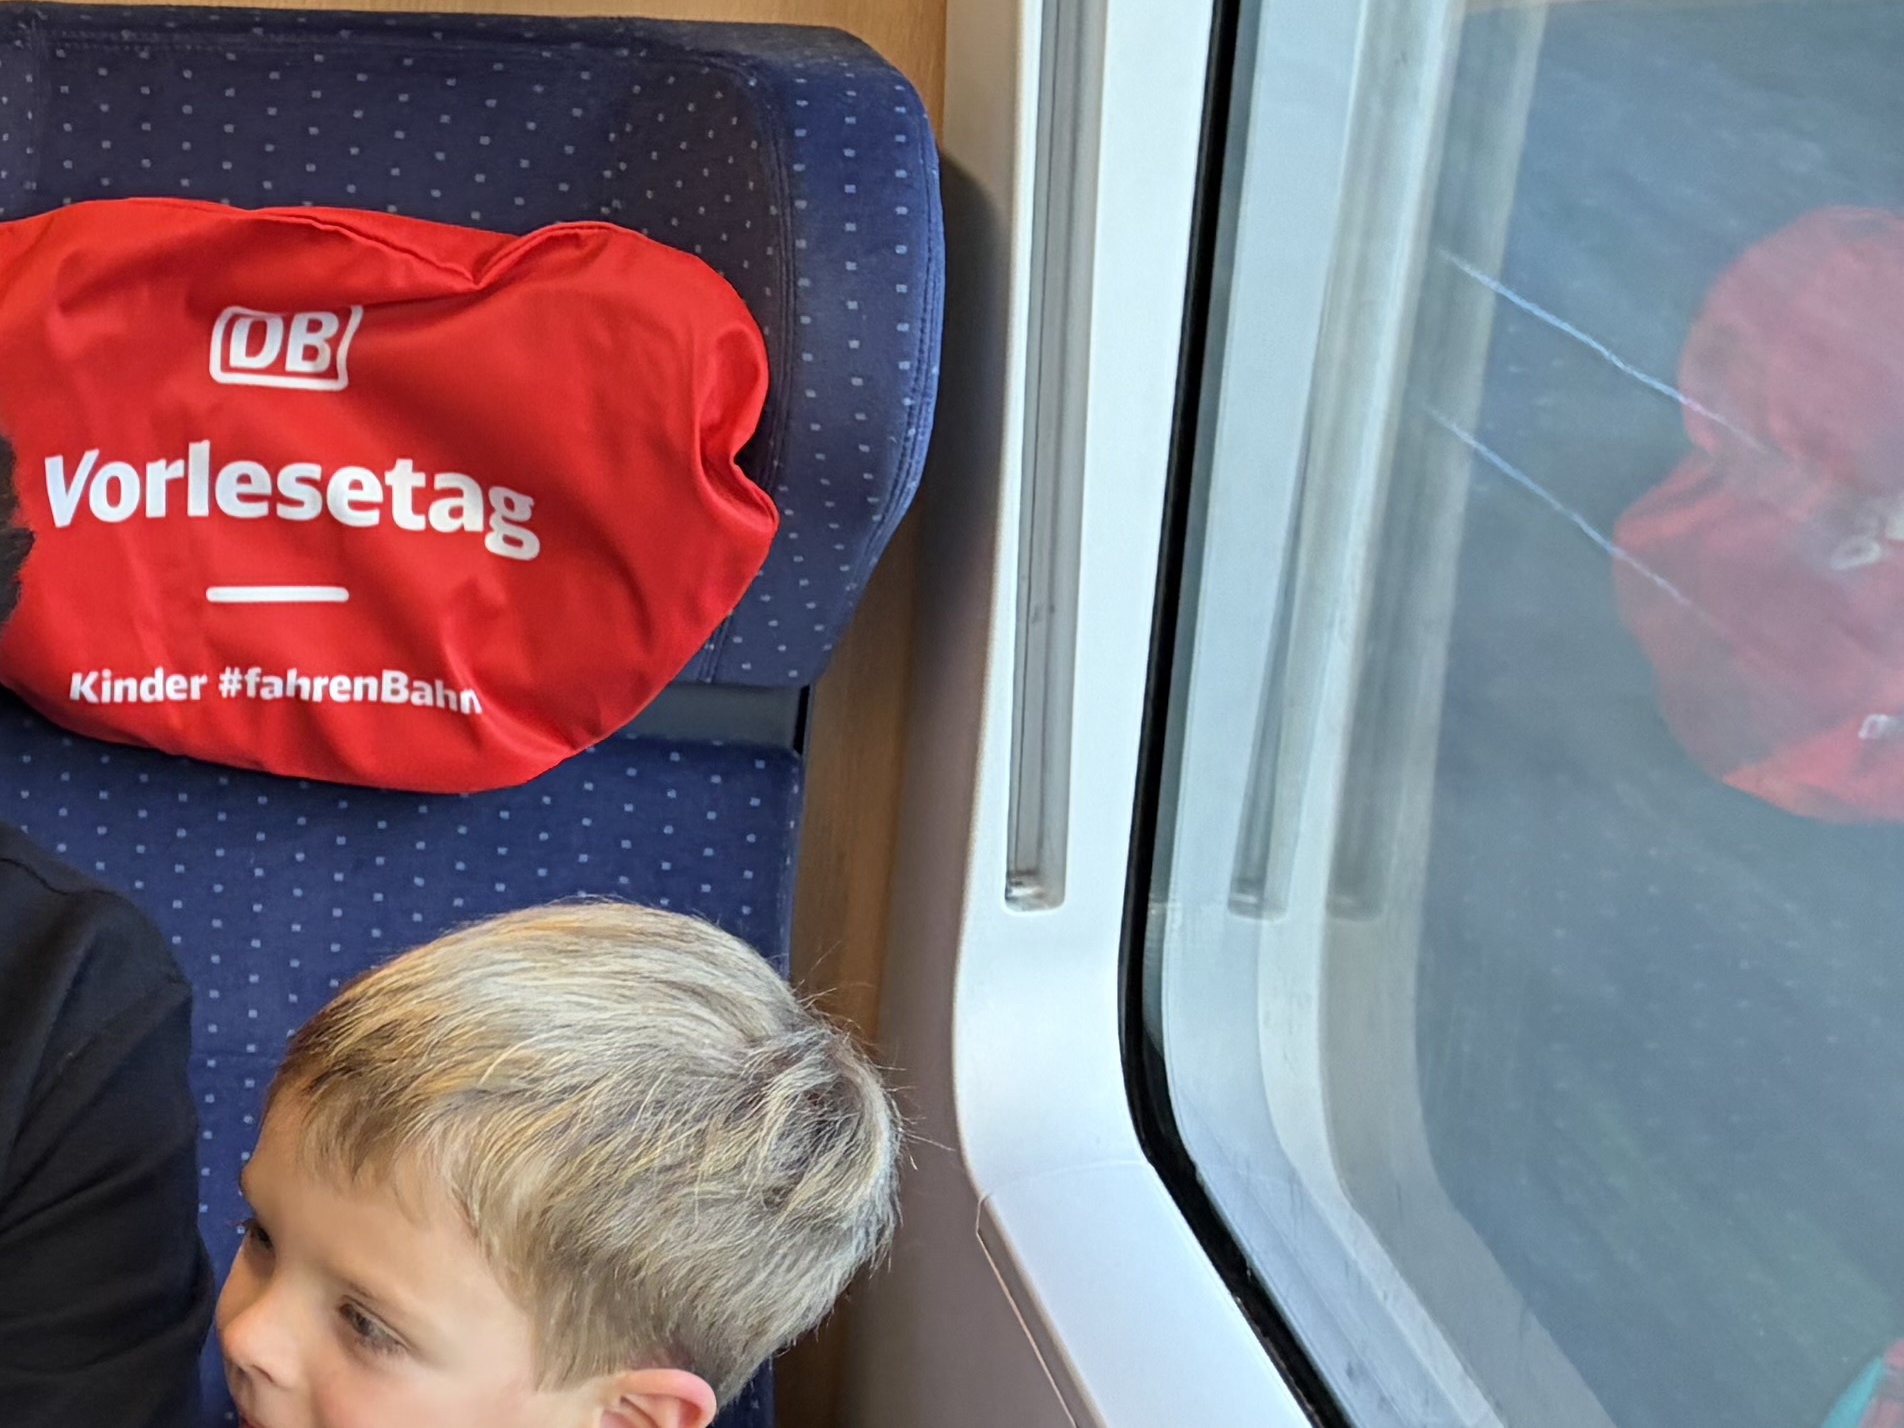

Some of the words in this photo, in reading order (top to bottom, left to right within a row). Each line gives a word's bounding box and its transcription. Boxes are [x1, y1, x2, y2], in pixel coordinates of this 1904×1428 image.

[227, 310, 341, 373] DB
[44, 439, 541, 561] Vorlesetag
[69, 667, 208, 704] Kinder
[218, 667, 483, 715] #fahrenBahn
